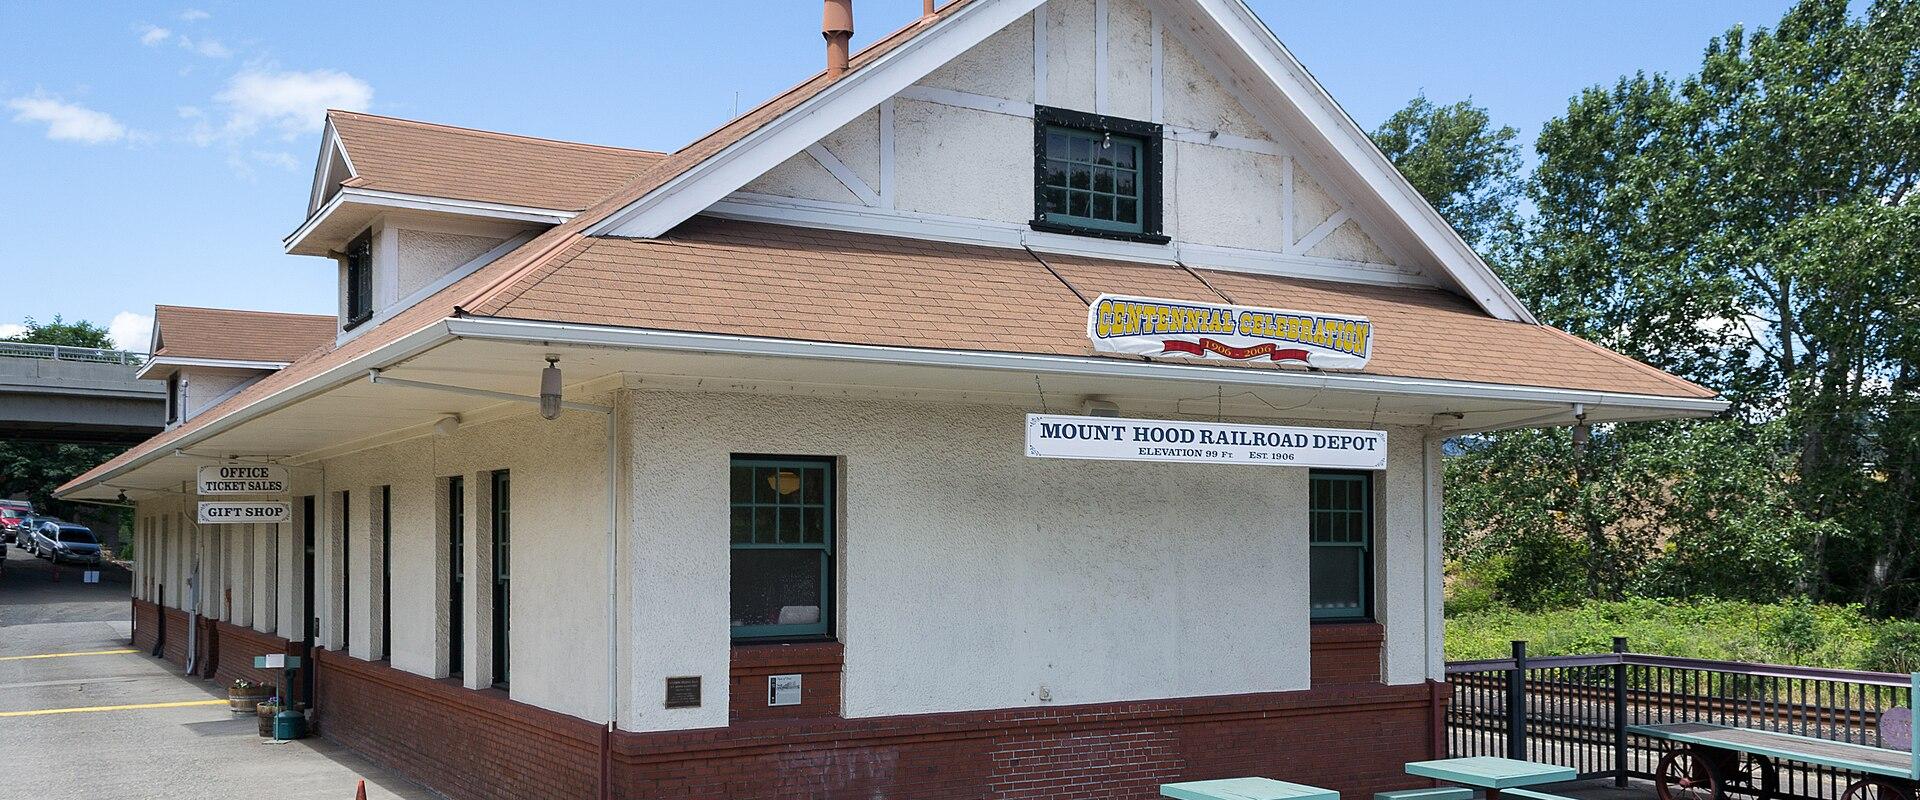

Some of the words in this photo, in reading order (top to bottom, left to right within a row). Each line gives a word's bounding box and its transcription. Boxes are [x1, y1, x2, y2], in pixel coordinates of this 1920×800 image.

[1097, 300, 1236, 338] CENTENNIAL
[1239, 312, 1369, 358] CELEBRATION
[1205, 341, 1231, 356] 1906
[1244, 345, 1271, 357] 2006
[1040, 423, 1126, 441] MOUNT
[1132, 427, 1195, 444] HOOD
[1199, 430, 1308, 448] RAILROAD
[1313, 434, 1377, 451] DEPOT
[1138, 447, 1203, 458] ELEVATION
[1205, 450, 1218, 458] 99
[1271, 452, 1295, 461] 1906
[220, 467, 269, 478] OFFICE
[206, 481, 246, 491] TICKET
[248, 481, 282, 491] SALES
[208, 507, 242, 517] GIFT
[245, 507, 283, 517] SHOP
